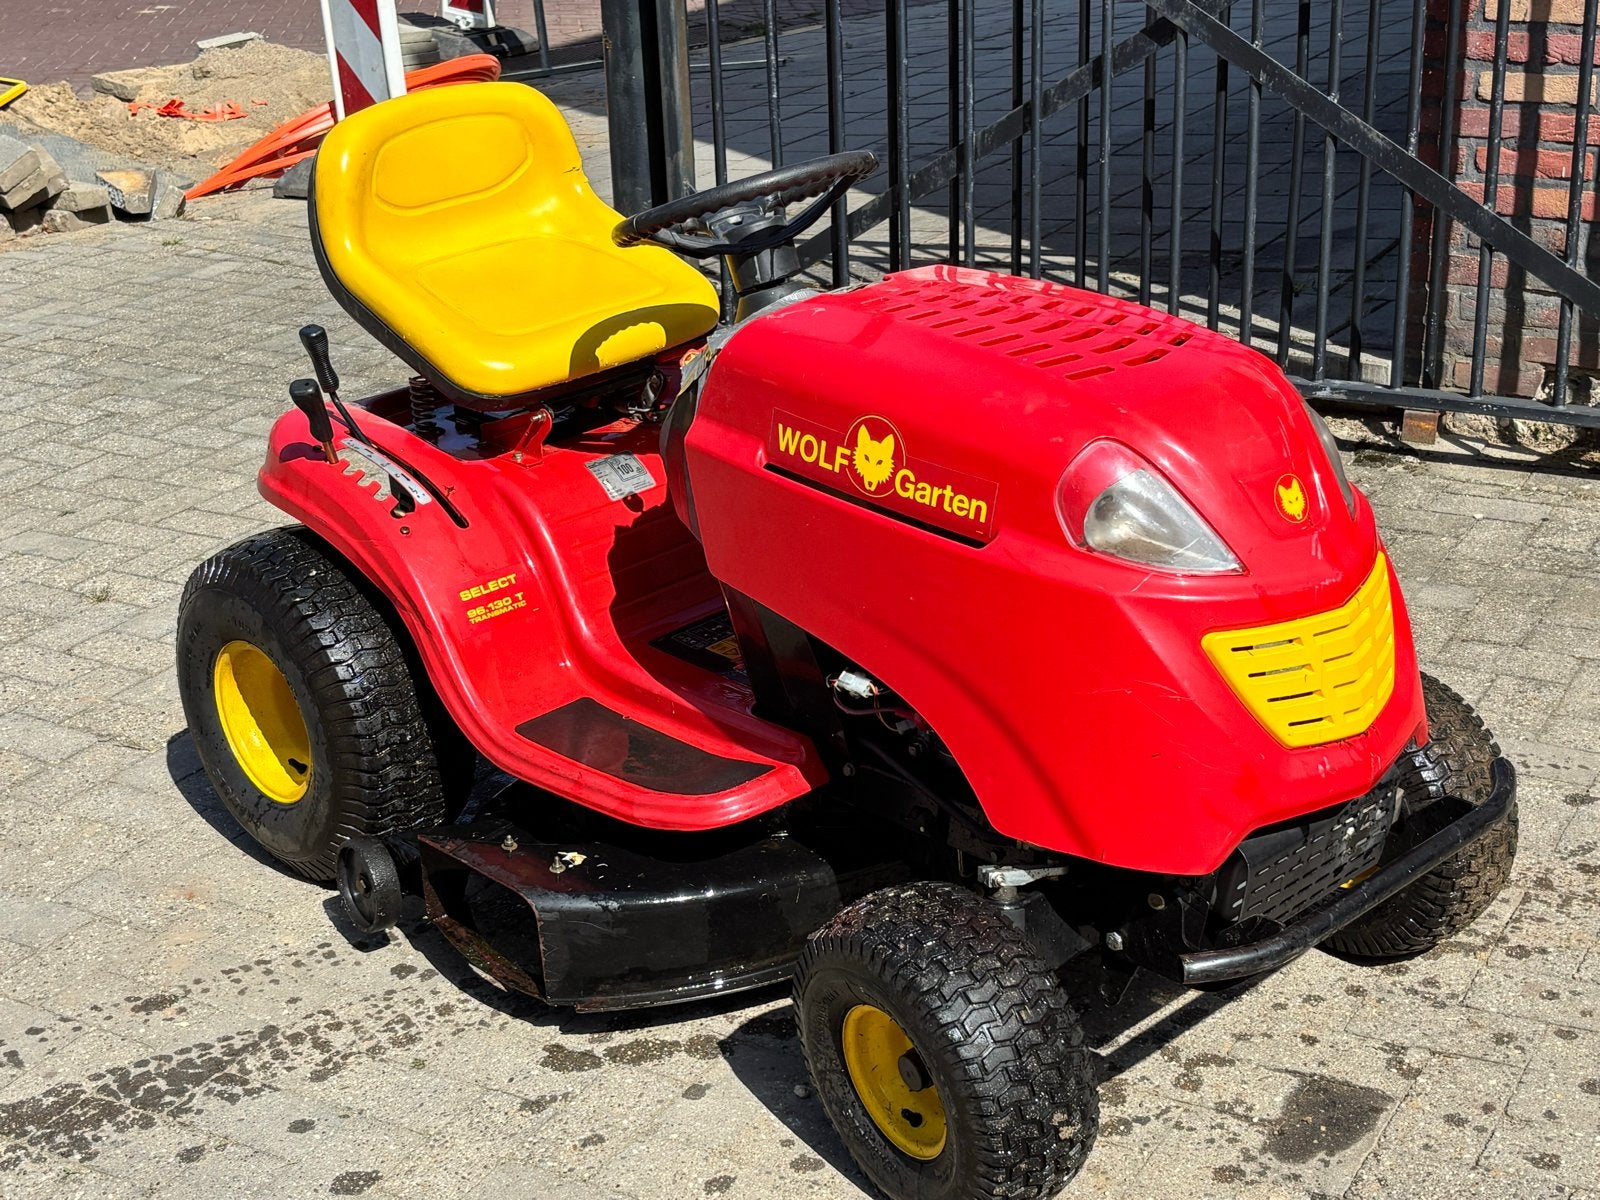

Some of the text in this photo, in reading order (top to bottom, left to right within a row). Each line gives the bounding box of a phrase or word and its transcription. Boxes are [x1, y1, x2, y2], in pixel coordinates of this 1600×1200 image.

[616, 463, 634, 475] 100
[778, 423, 988, 523] WOLF Garten
[459, 573, 517, 601] SELECT
[467, 592, 524, 618] 96.130 T
[469, 600, 527, 624] TRANSMATIC
